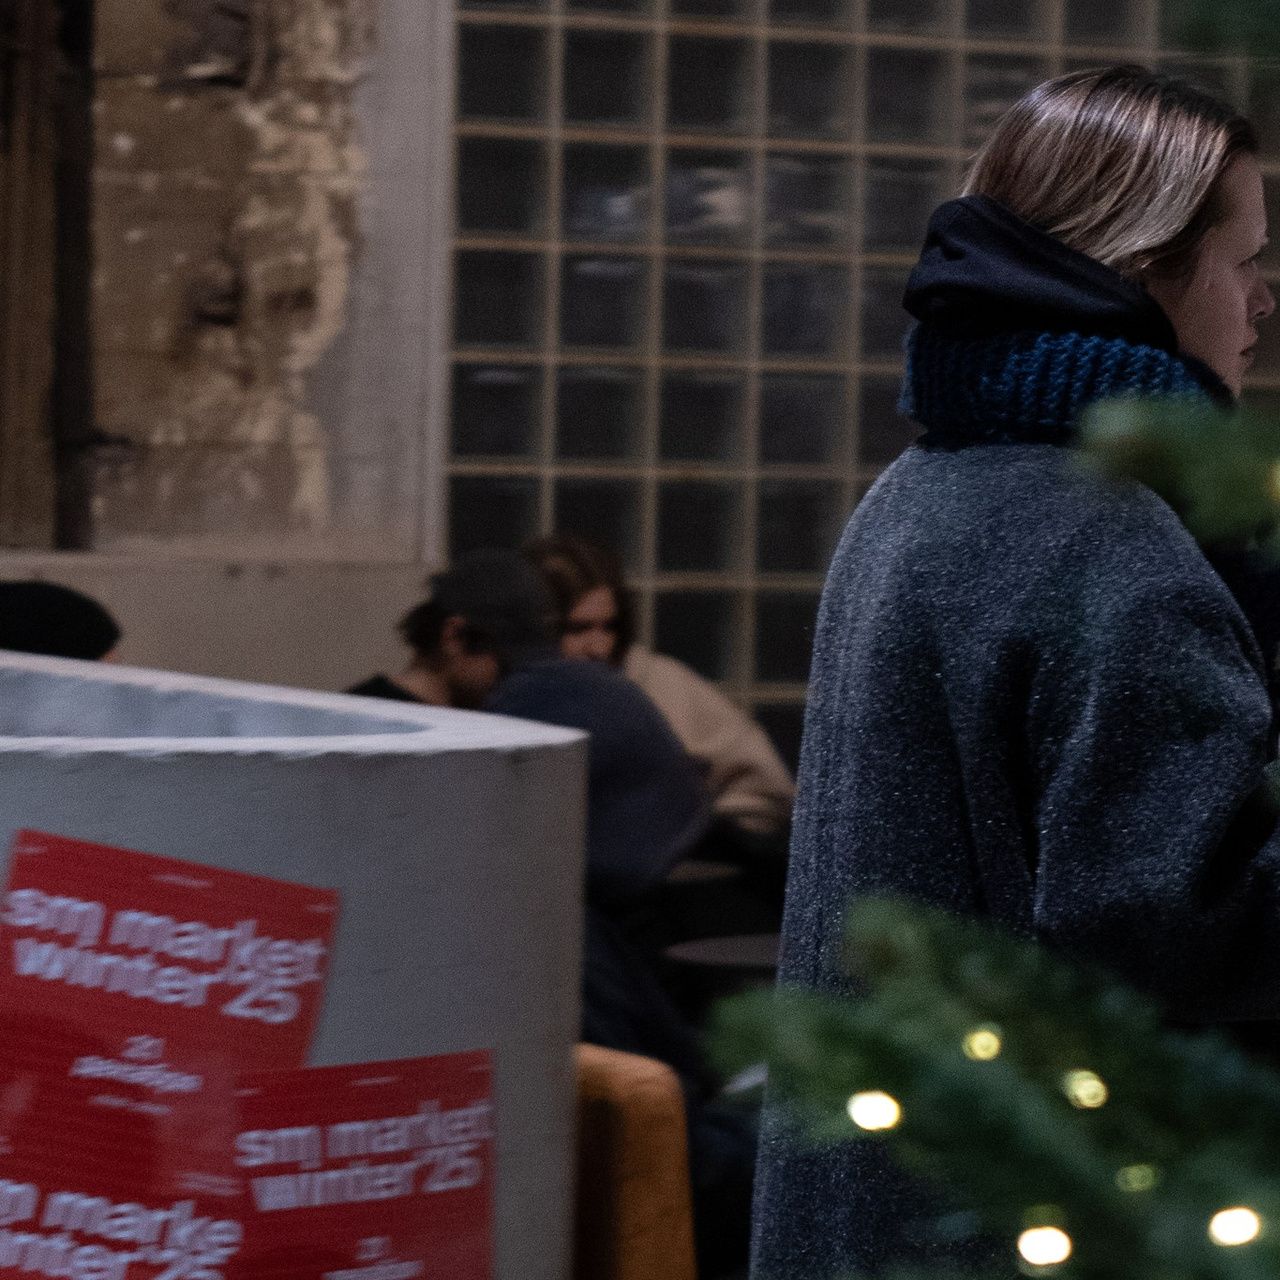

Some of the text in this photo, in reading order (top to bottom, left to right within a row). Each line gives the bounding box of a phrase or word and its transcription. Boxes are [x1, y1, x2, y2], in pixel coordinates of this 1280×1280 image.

[108, 910, 326, 983] market
[326, 1099, 496, 1158] market
[42, 1191, 243, 1252] marke
